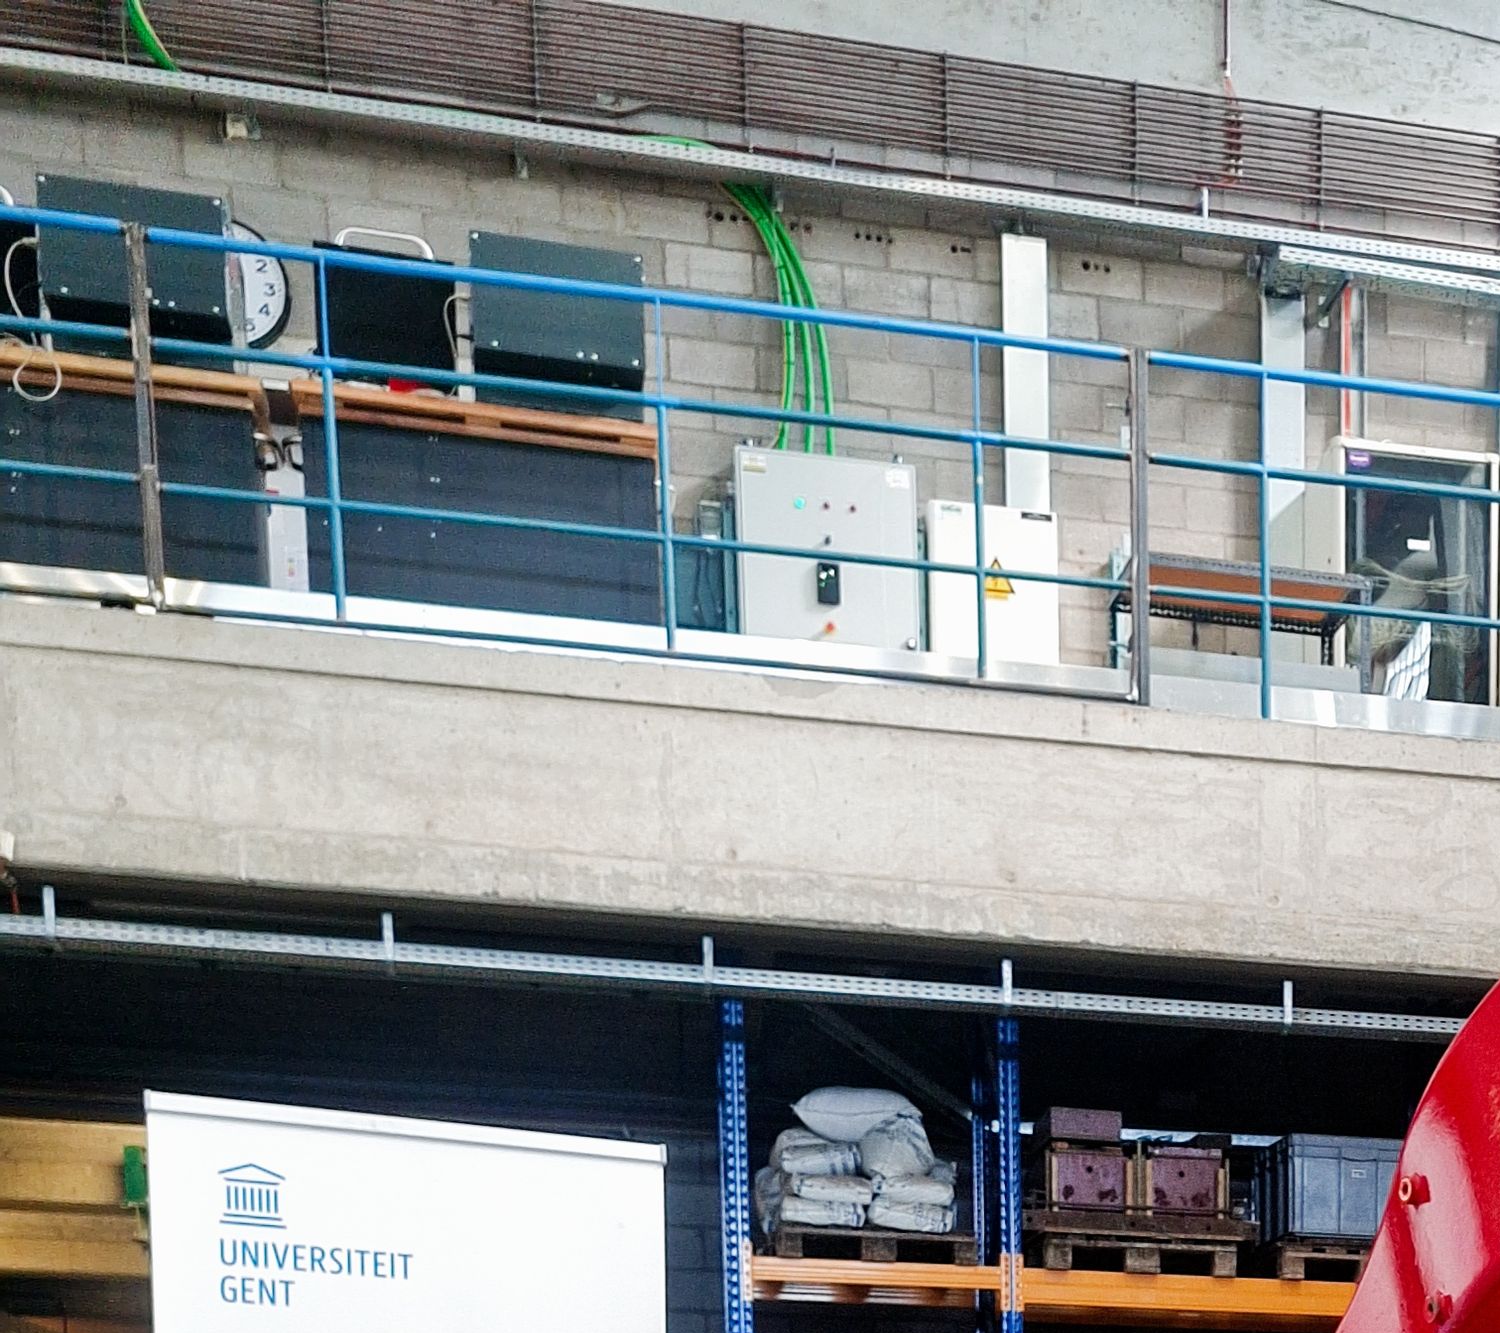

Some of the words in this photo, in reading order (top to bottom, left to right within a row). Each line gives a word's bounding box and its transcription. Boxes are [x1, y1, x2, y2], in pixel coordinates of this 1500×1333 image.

[255, 258, 268, 273] 2
[263, 282, 276, 297] 3
[258, 303, 270, 317] 4
[219, 1238, 414, 1280] UNIVERSITEIT
[220, 1275, 295, 1307] GENT
